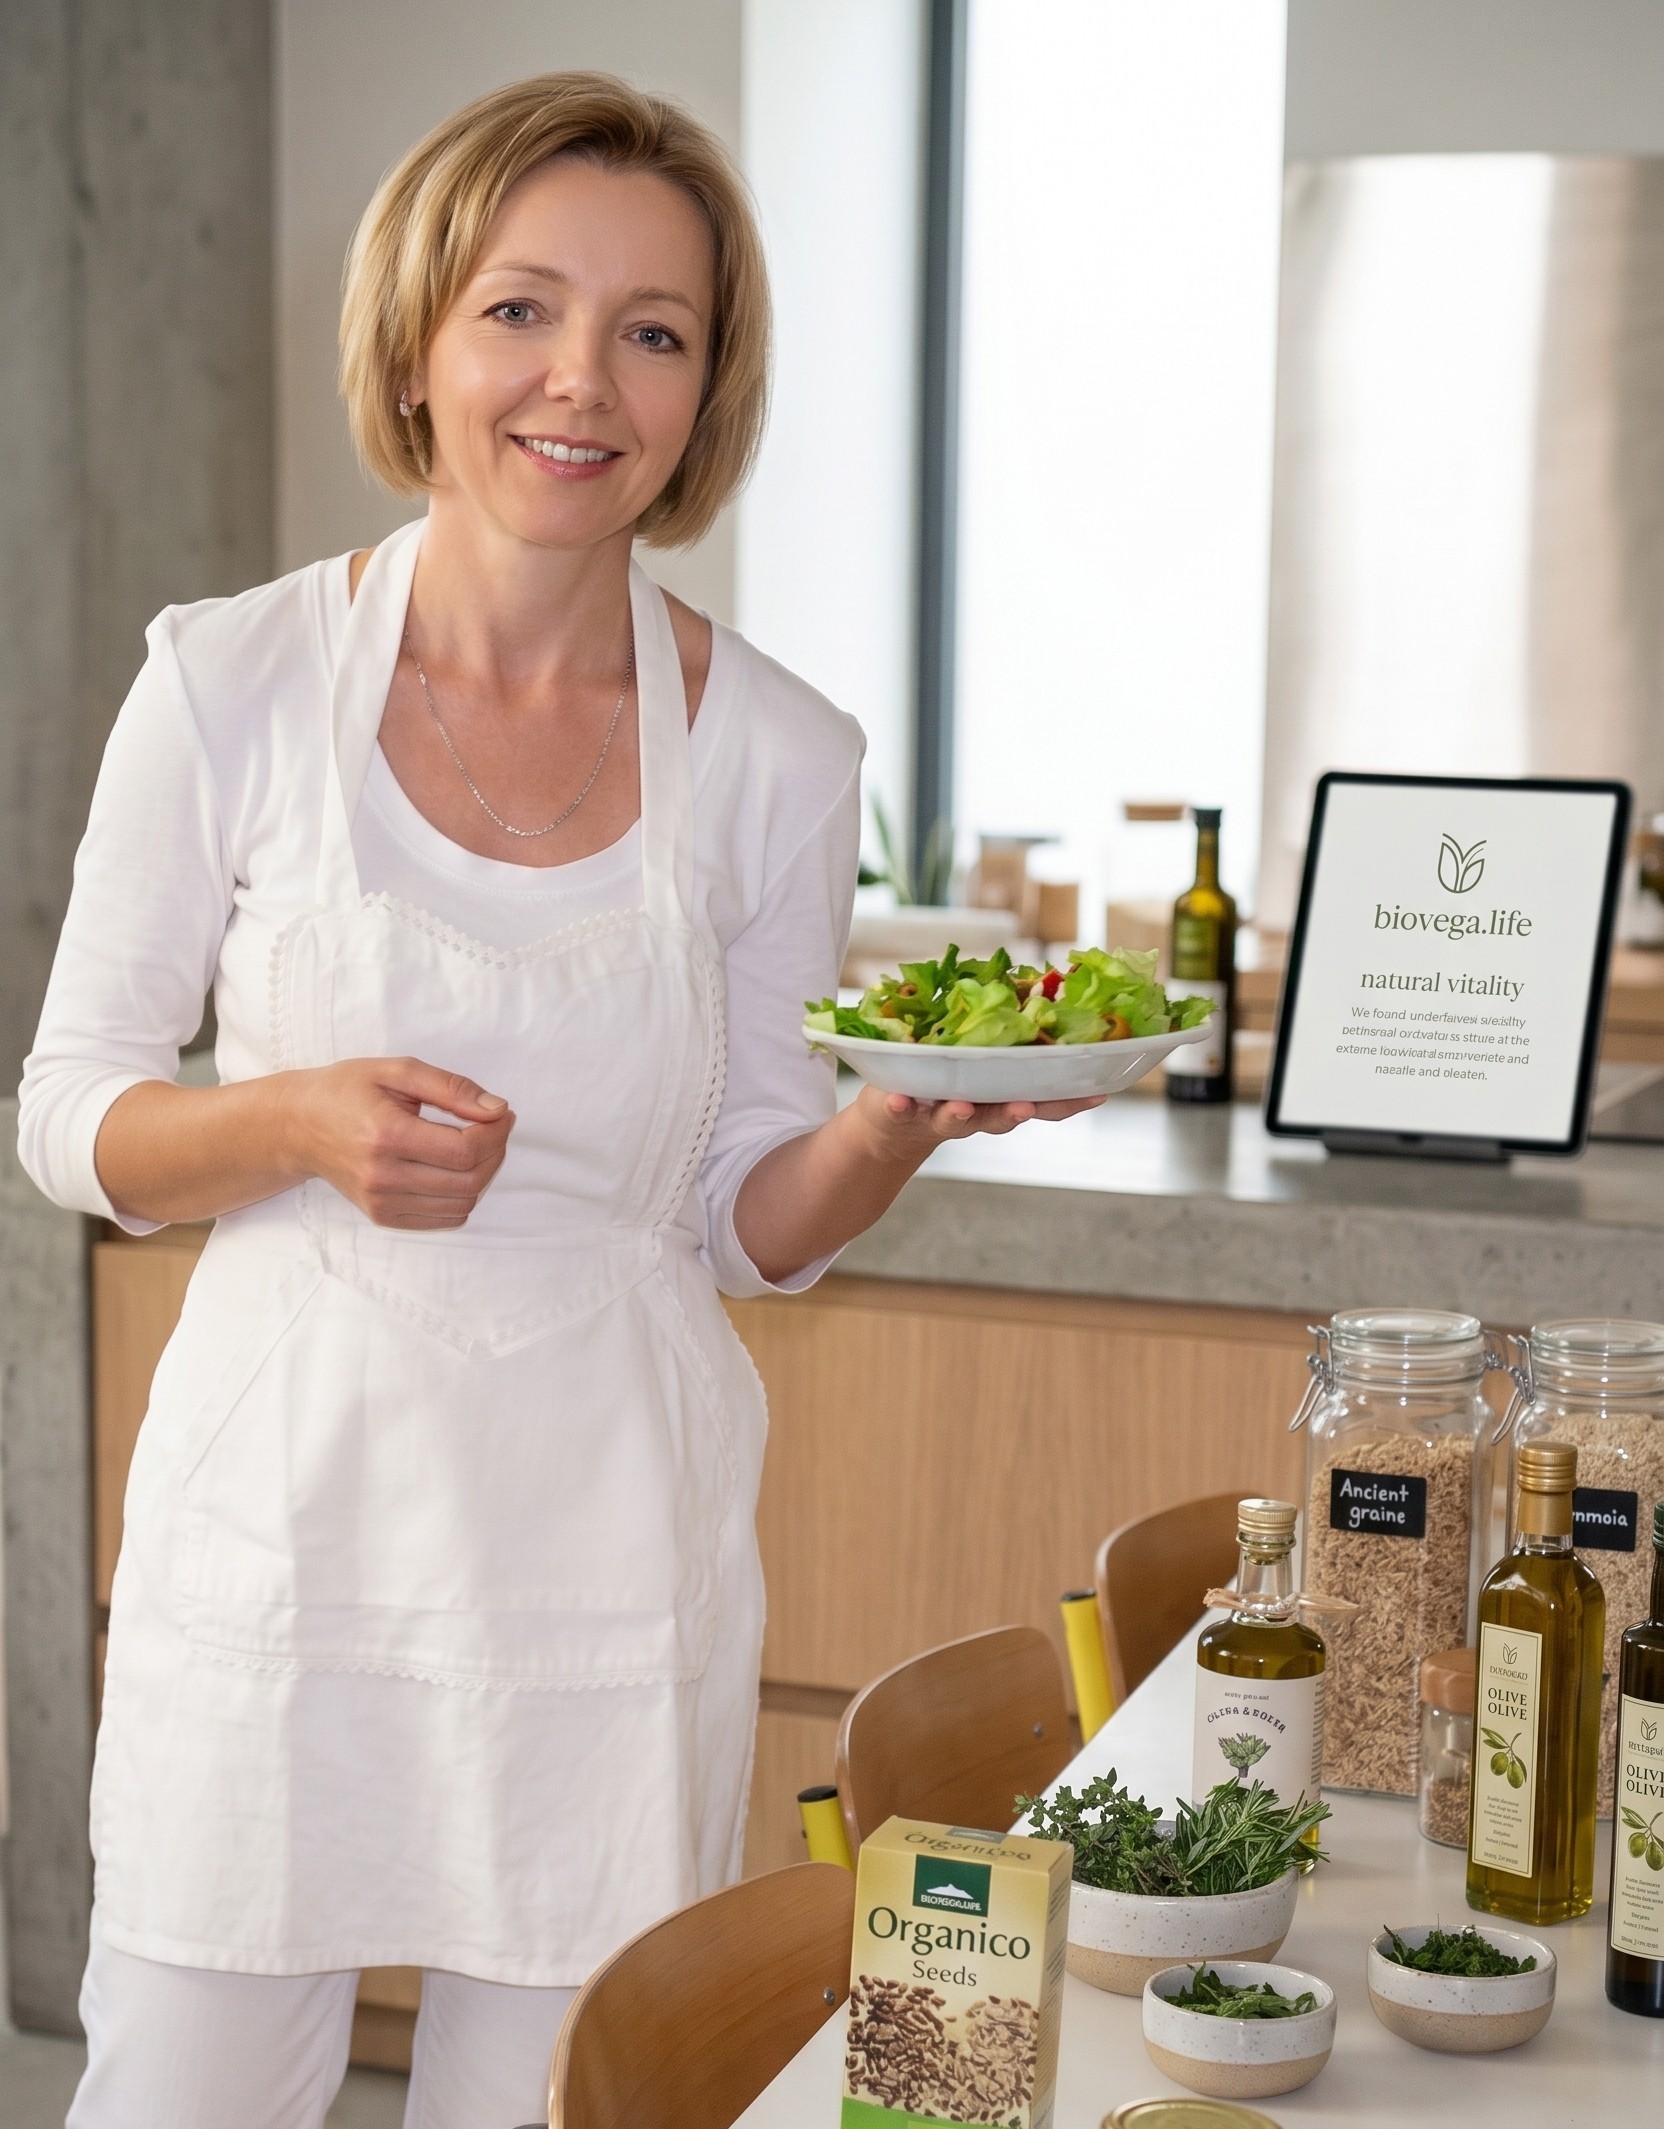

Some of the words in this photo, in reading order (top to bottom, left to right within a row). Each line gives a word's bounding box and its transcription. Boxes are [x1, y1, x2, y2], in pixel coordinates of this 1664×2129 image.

[1373, 903, 1533, 941] biovega.life
[1360, 971, 1441, 993] natural
[1447, 974, 1525, 1002] vitality
[1351, 1006, 1370, 1018] We
[1497, 1034, 1509, 1045] at
[1511, 1034, 1530, 1046] the
[1507, 1053, 1530, 1065] and
[1418, 1066, 1441, 1078] and
[1339, 1477, 1409, 1502] Ancient
[1349, 1505, 1406, 1528] graine
[1488, 1687, 1527, 1706] OLIVE
[1488, 1702, 1527, 1720] OLIVE
[867, 1906, 1031, 1960] Organico
[912, 1960, 977, 1987] Seeds
